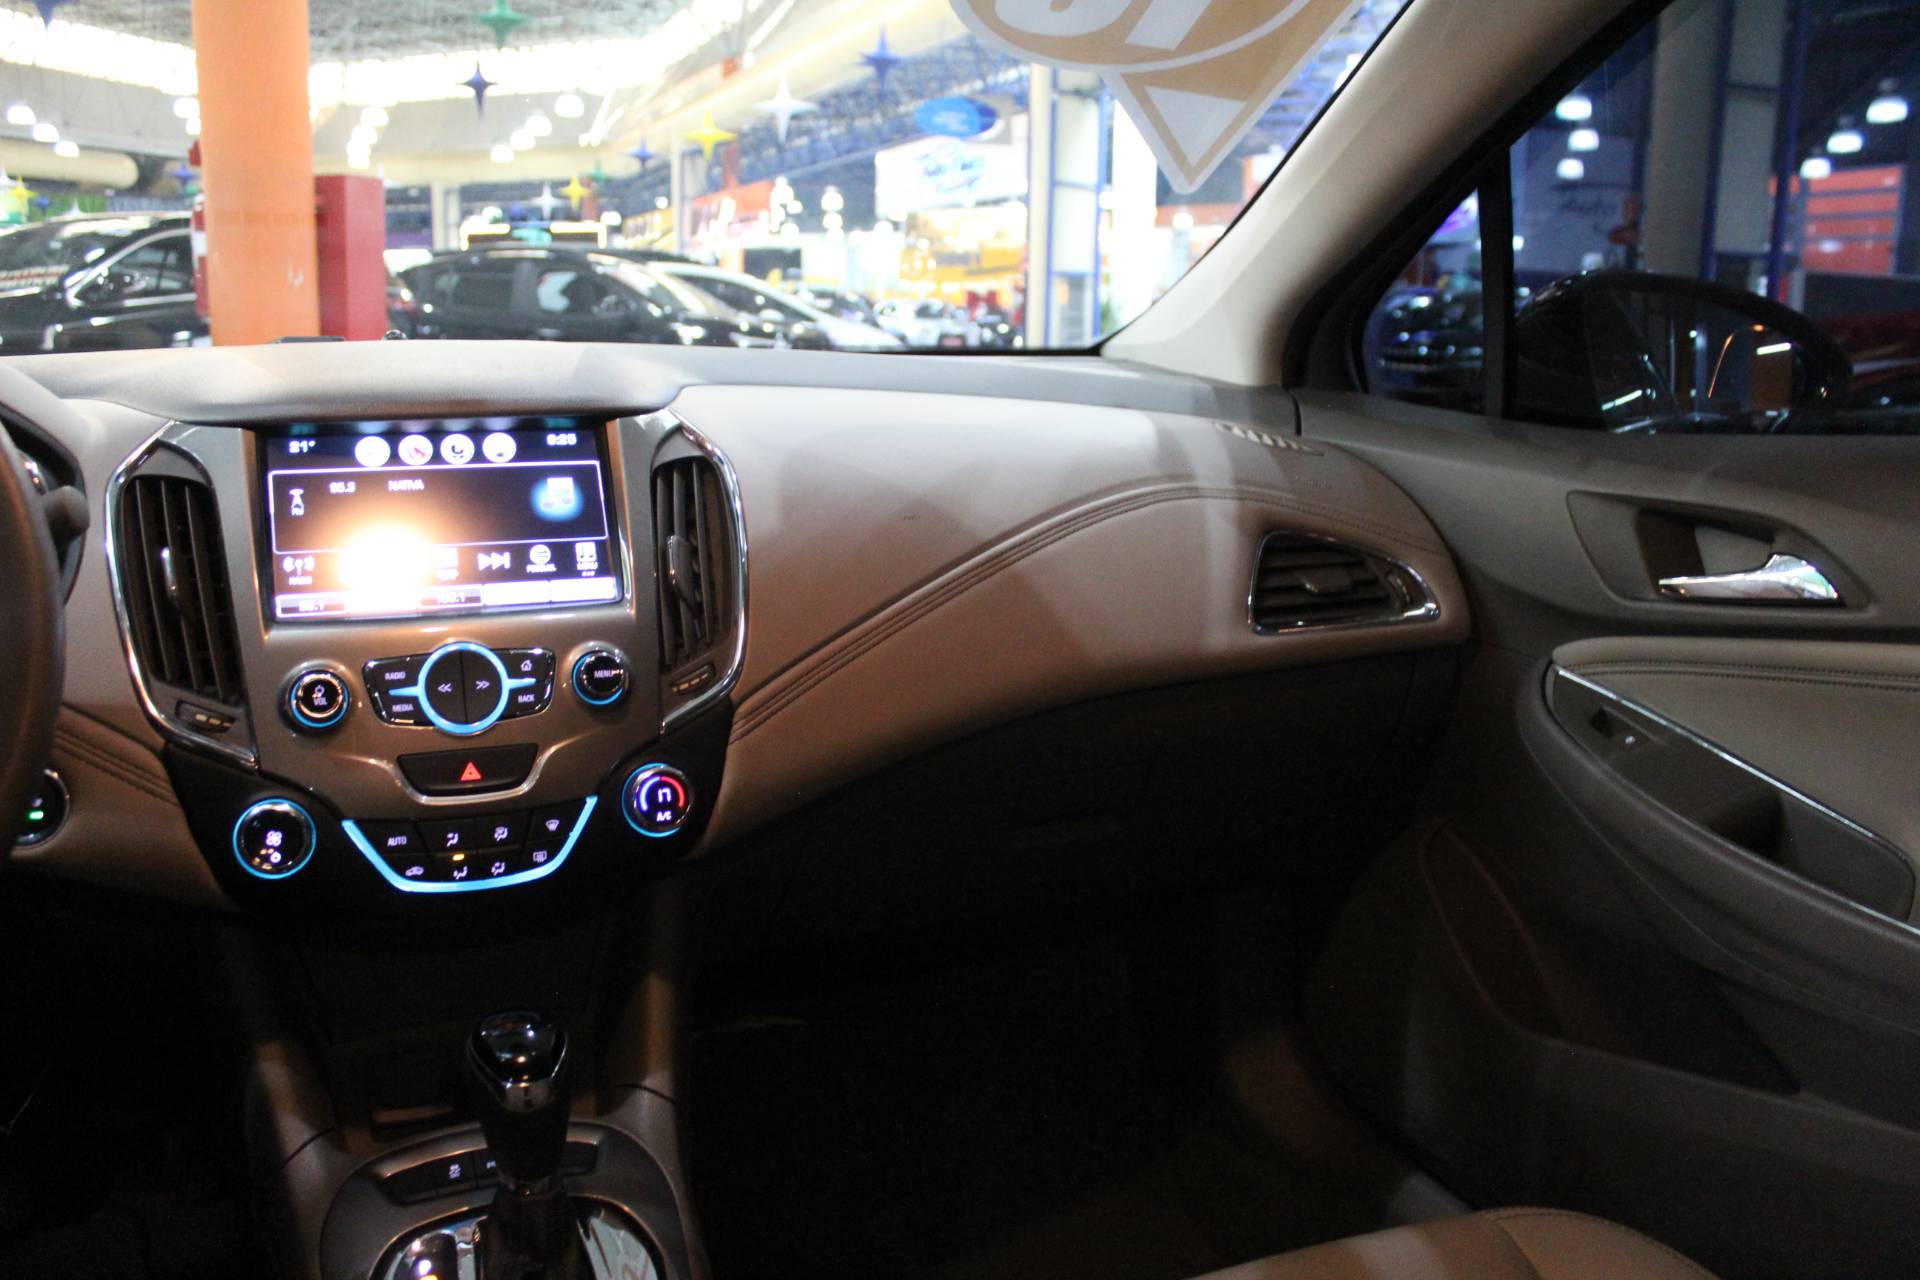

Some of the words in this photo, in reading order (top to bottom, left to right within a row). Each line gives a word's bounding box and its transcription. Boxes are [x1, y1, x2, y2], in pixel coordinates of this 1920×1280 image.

[388, 478, 425, 491] NATIVA
[384, 671, 407, 681] RADIO
[594, 669, 613, 679] MENU
[313, 697, 327, 706] VOL
[517, 694, 535, 704] BACK
[392, 704, 414, 713] MEDIA
[387, 836, 408, 847] AUTO
